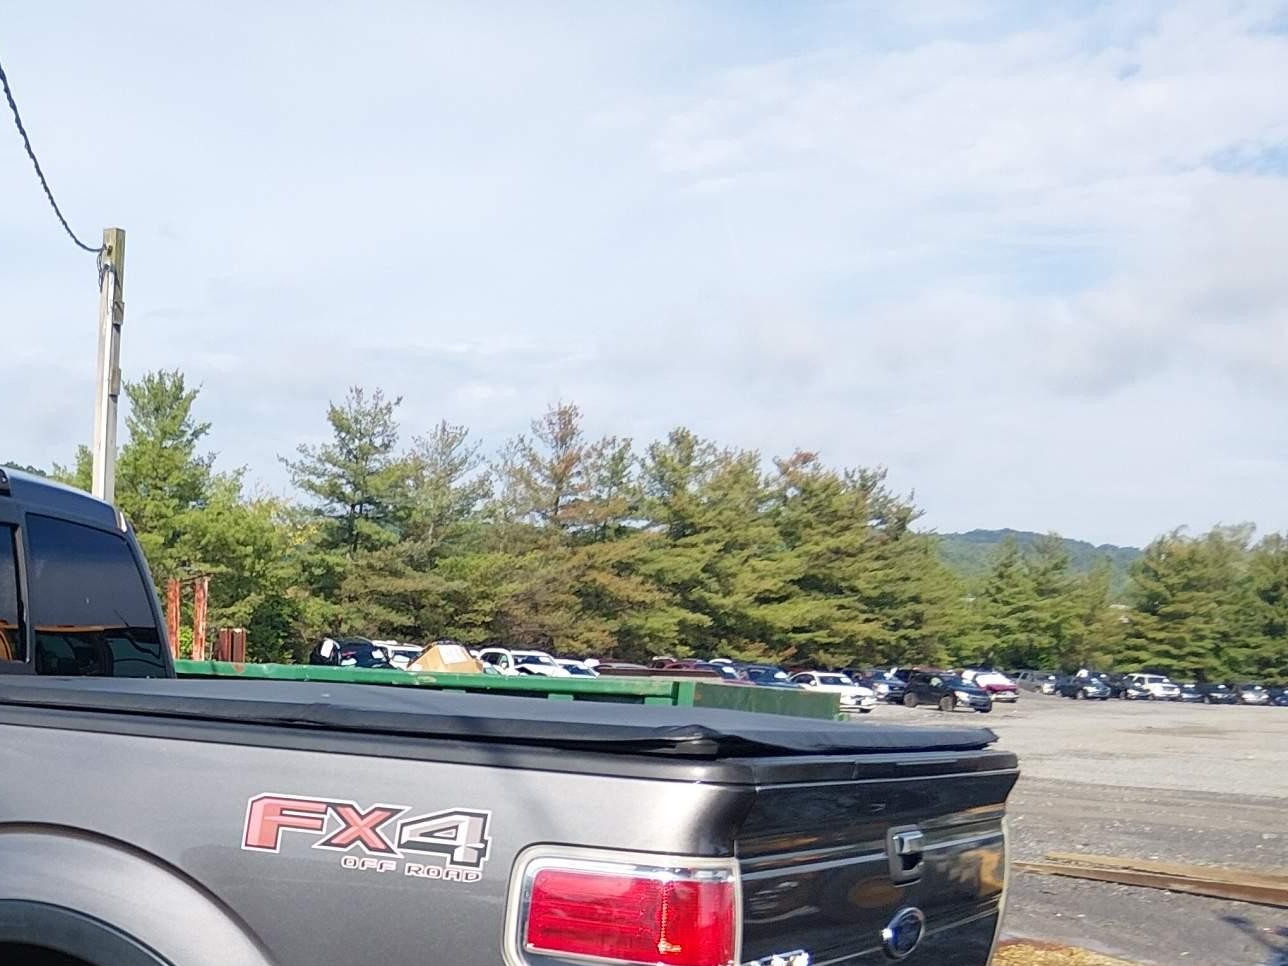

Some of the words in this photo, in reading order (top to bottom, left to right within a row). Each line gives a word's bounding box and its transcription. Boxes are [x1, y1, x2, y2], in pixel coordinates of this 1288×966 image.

[241, 792, 492, 870] FX4
[341, 855, 397, 873] OFF
[404, 862, 483, 883] ROAD
